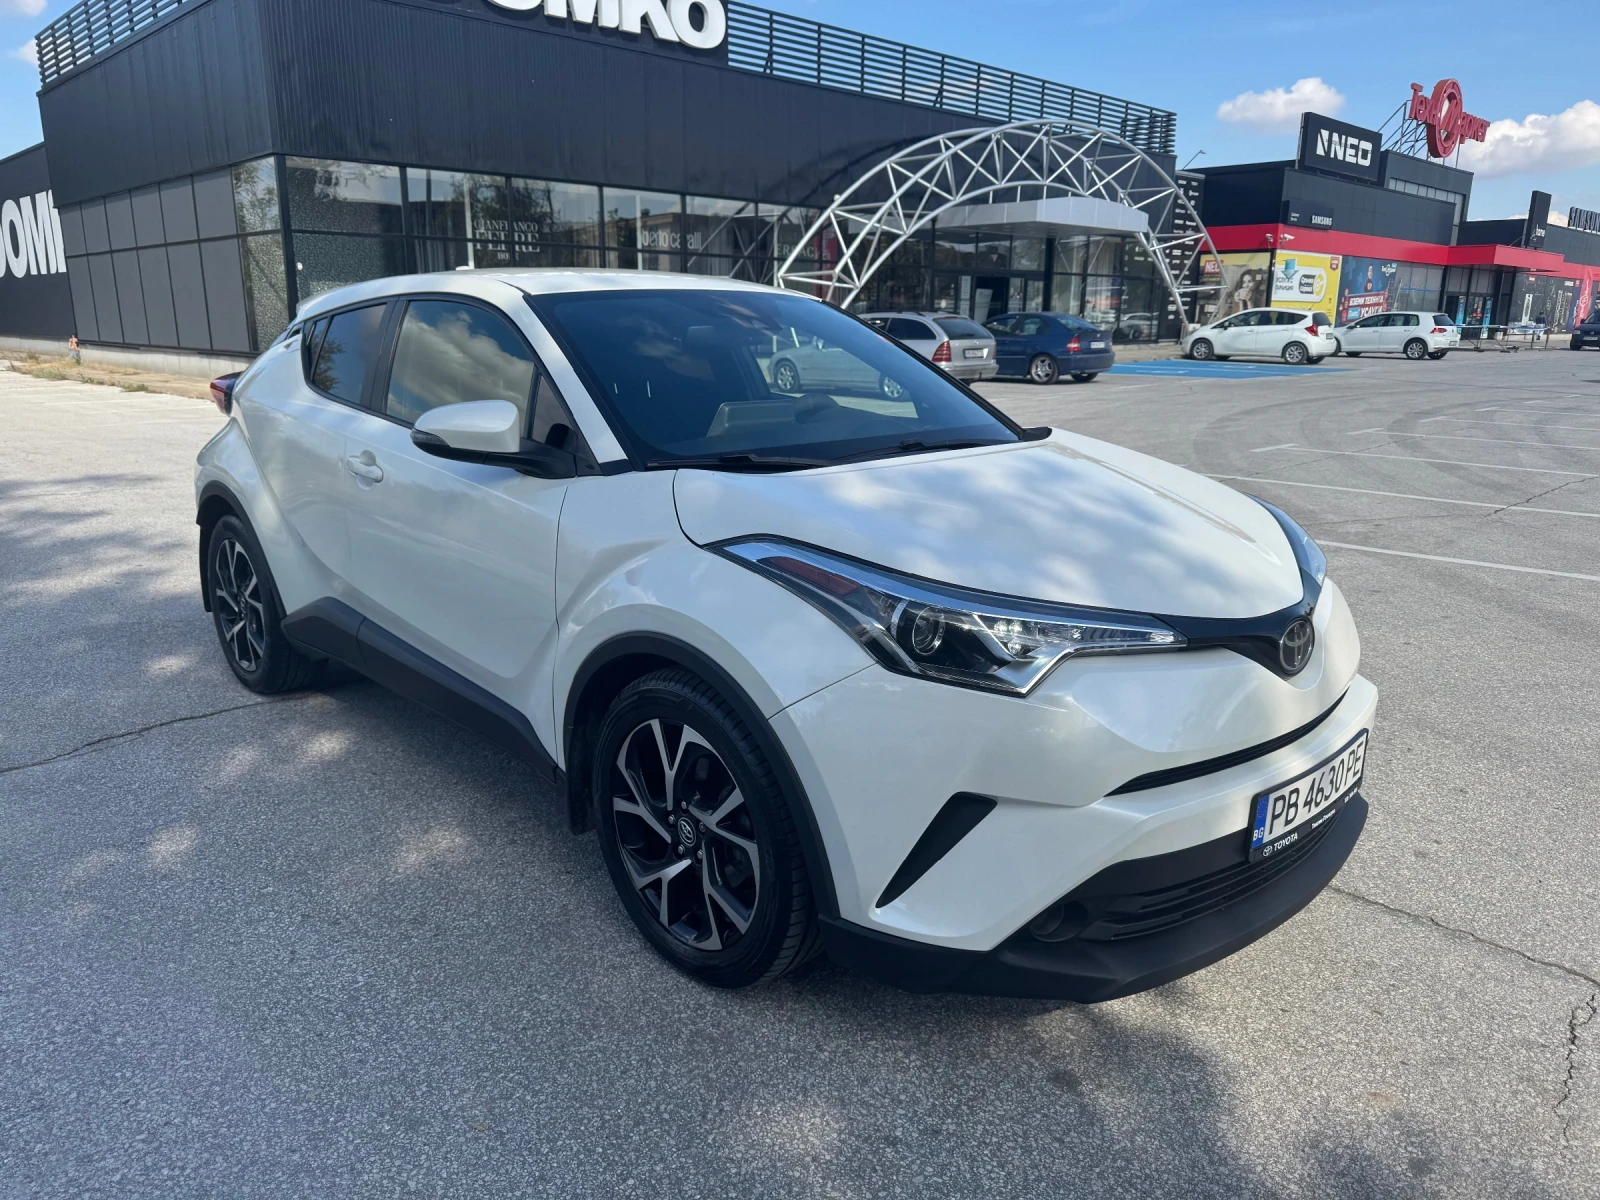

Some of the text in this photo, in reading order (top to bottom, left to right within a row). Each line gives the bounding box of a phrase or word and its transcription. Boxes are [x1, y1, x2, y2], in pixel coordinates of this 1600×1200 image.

[486, 0, 727, 49] KO
[1330, 132, 1373, 167] NEO
[474, 220, 539, 232] GIANFANCO
[1311, 215, 1333, 226] SAMSUNG
[0, 189, 67, 278] OM
[670, 232, 702, 250] caalli
[1269, 787, 1300, 835] PB
[1302, 758, 1345, 814] 4630
[1344, 741, 1364, 786] PE
[1253, 826, 1264, 841] BG
[1273, 832, 1298, 851] TOYOTA
